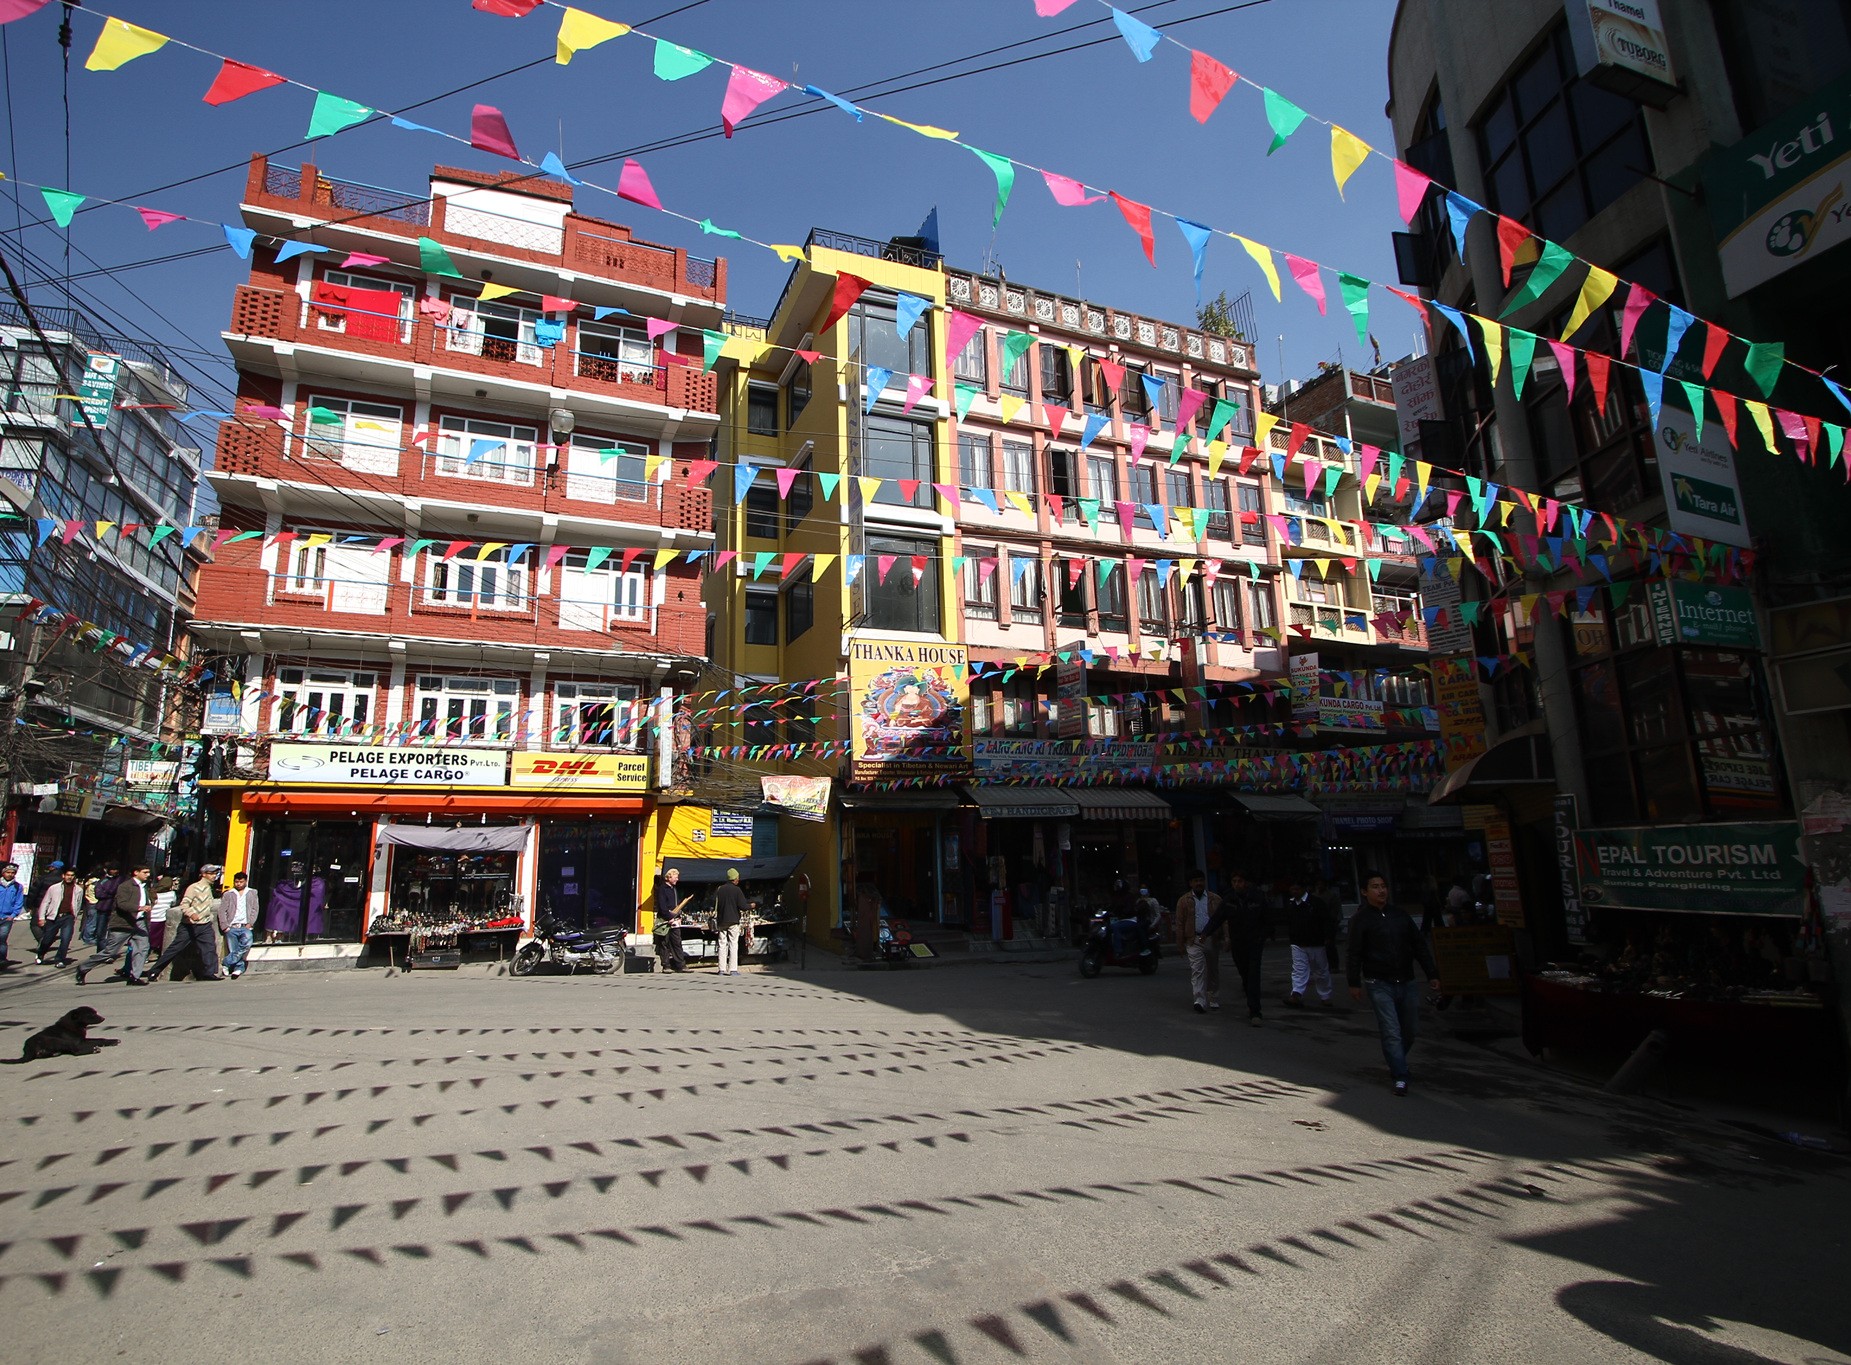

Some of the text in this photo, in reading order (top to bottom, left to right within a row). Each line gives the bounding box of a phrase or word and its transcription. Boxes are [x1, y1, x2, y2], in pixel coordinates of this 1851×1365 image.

[1617, 37, 1667, 67] TUBORG
[1747, 111, 1835, 181] Yeti
[82, 379, 114, 390] SAVINGS
[1700, 446, 1729, 463] Airlines
[1693, 494, 1737, 517] Tara Air
[1652, 583, 1674, 645] INTERNET
[1677, 600, 1756, 625] Internet
[854, 643, 966, 665] THANKA HOUSE
[1342, 699, 1364, 710] CARGO
[131, 761, 155, 771] TIBET
[330, 751, 384, 764] PELAGE
[389, 752, 468, 766] EXPORTERS
[350, 768, 464, 780] PELAGE CARGO
[531, 760, 645, 775] DHL Parcel
[617, 773, 647, 782] Service
[1007, 806, 1075, 816] HANDICRAFT
[1574, 834, 1778, 878] NEPAL TOURISM
[1601, 868, 1782, 880] Travel & Adventure Pvt. Ltd
[1603, 879, 1644, 887] Sunrise
[1648, 880, 1732, 892] Paragliding
